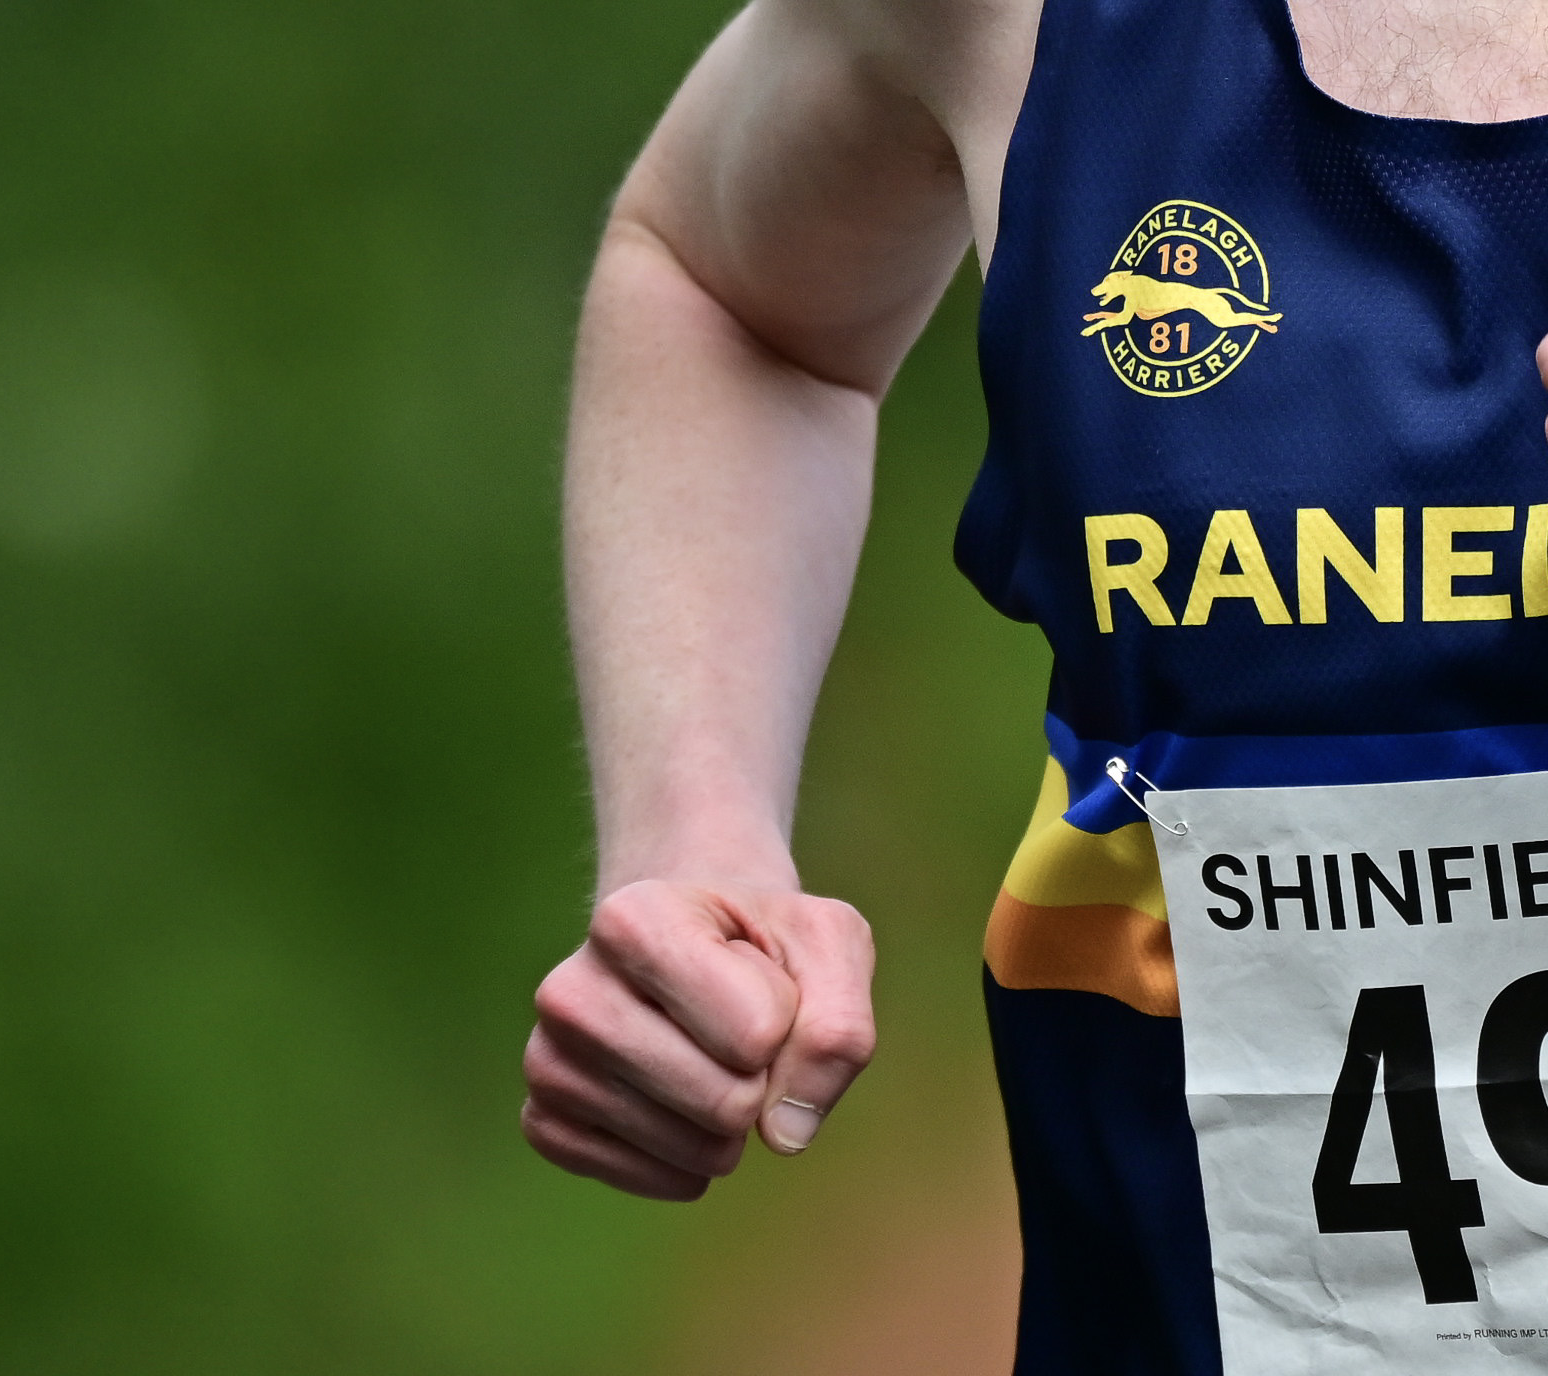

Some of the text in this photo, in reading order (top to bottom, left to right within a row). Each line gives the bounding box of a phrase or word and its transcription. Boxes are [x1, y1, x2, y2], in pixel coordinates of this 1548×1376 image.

[1121, 208, 1253, 268] RANELAGH
[1157, 243, 1198, 276] 18
[1149, 321, 1190, 354] 81
[1113, 339, 1240, 389] HARRIERS
[1436, 1332, 1462, 1341] Printed
[1463, 1332, 1472, 1341] by
[1474, 1328, 1518, 1339] RUNNING
[1519, 1329, 1537, 1338] IMP
